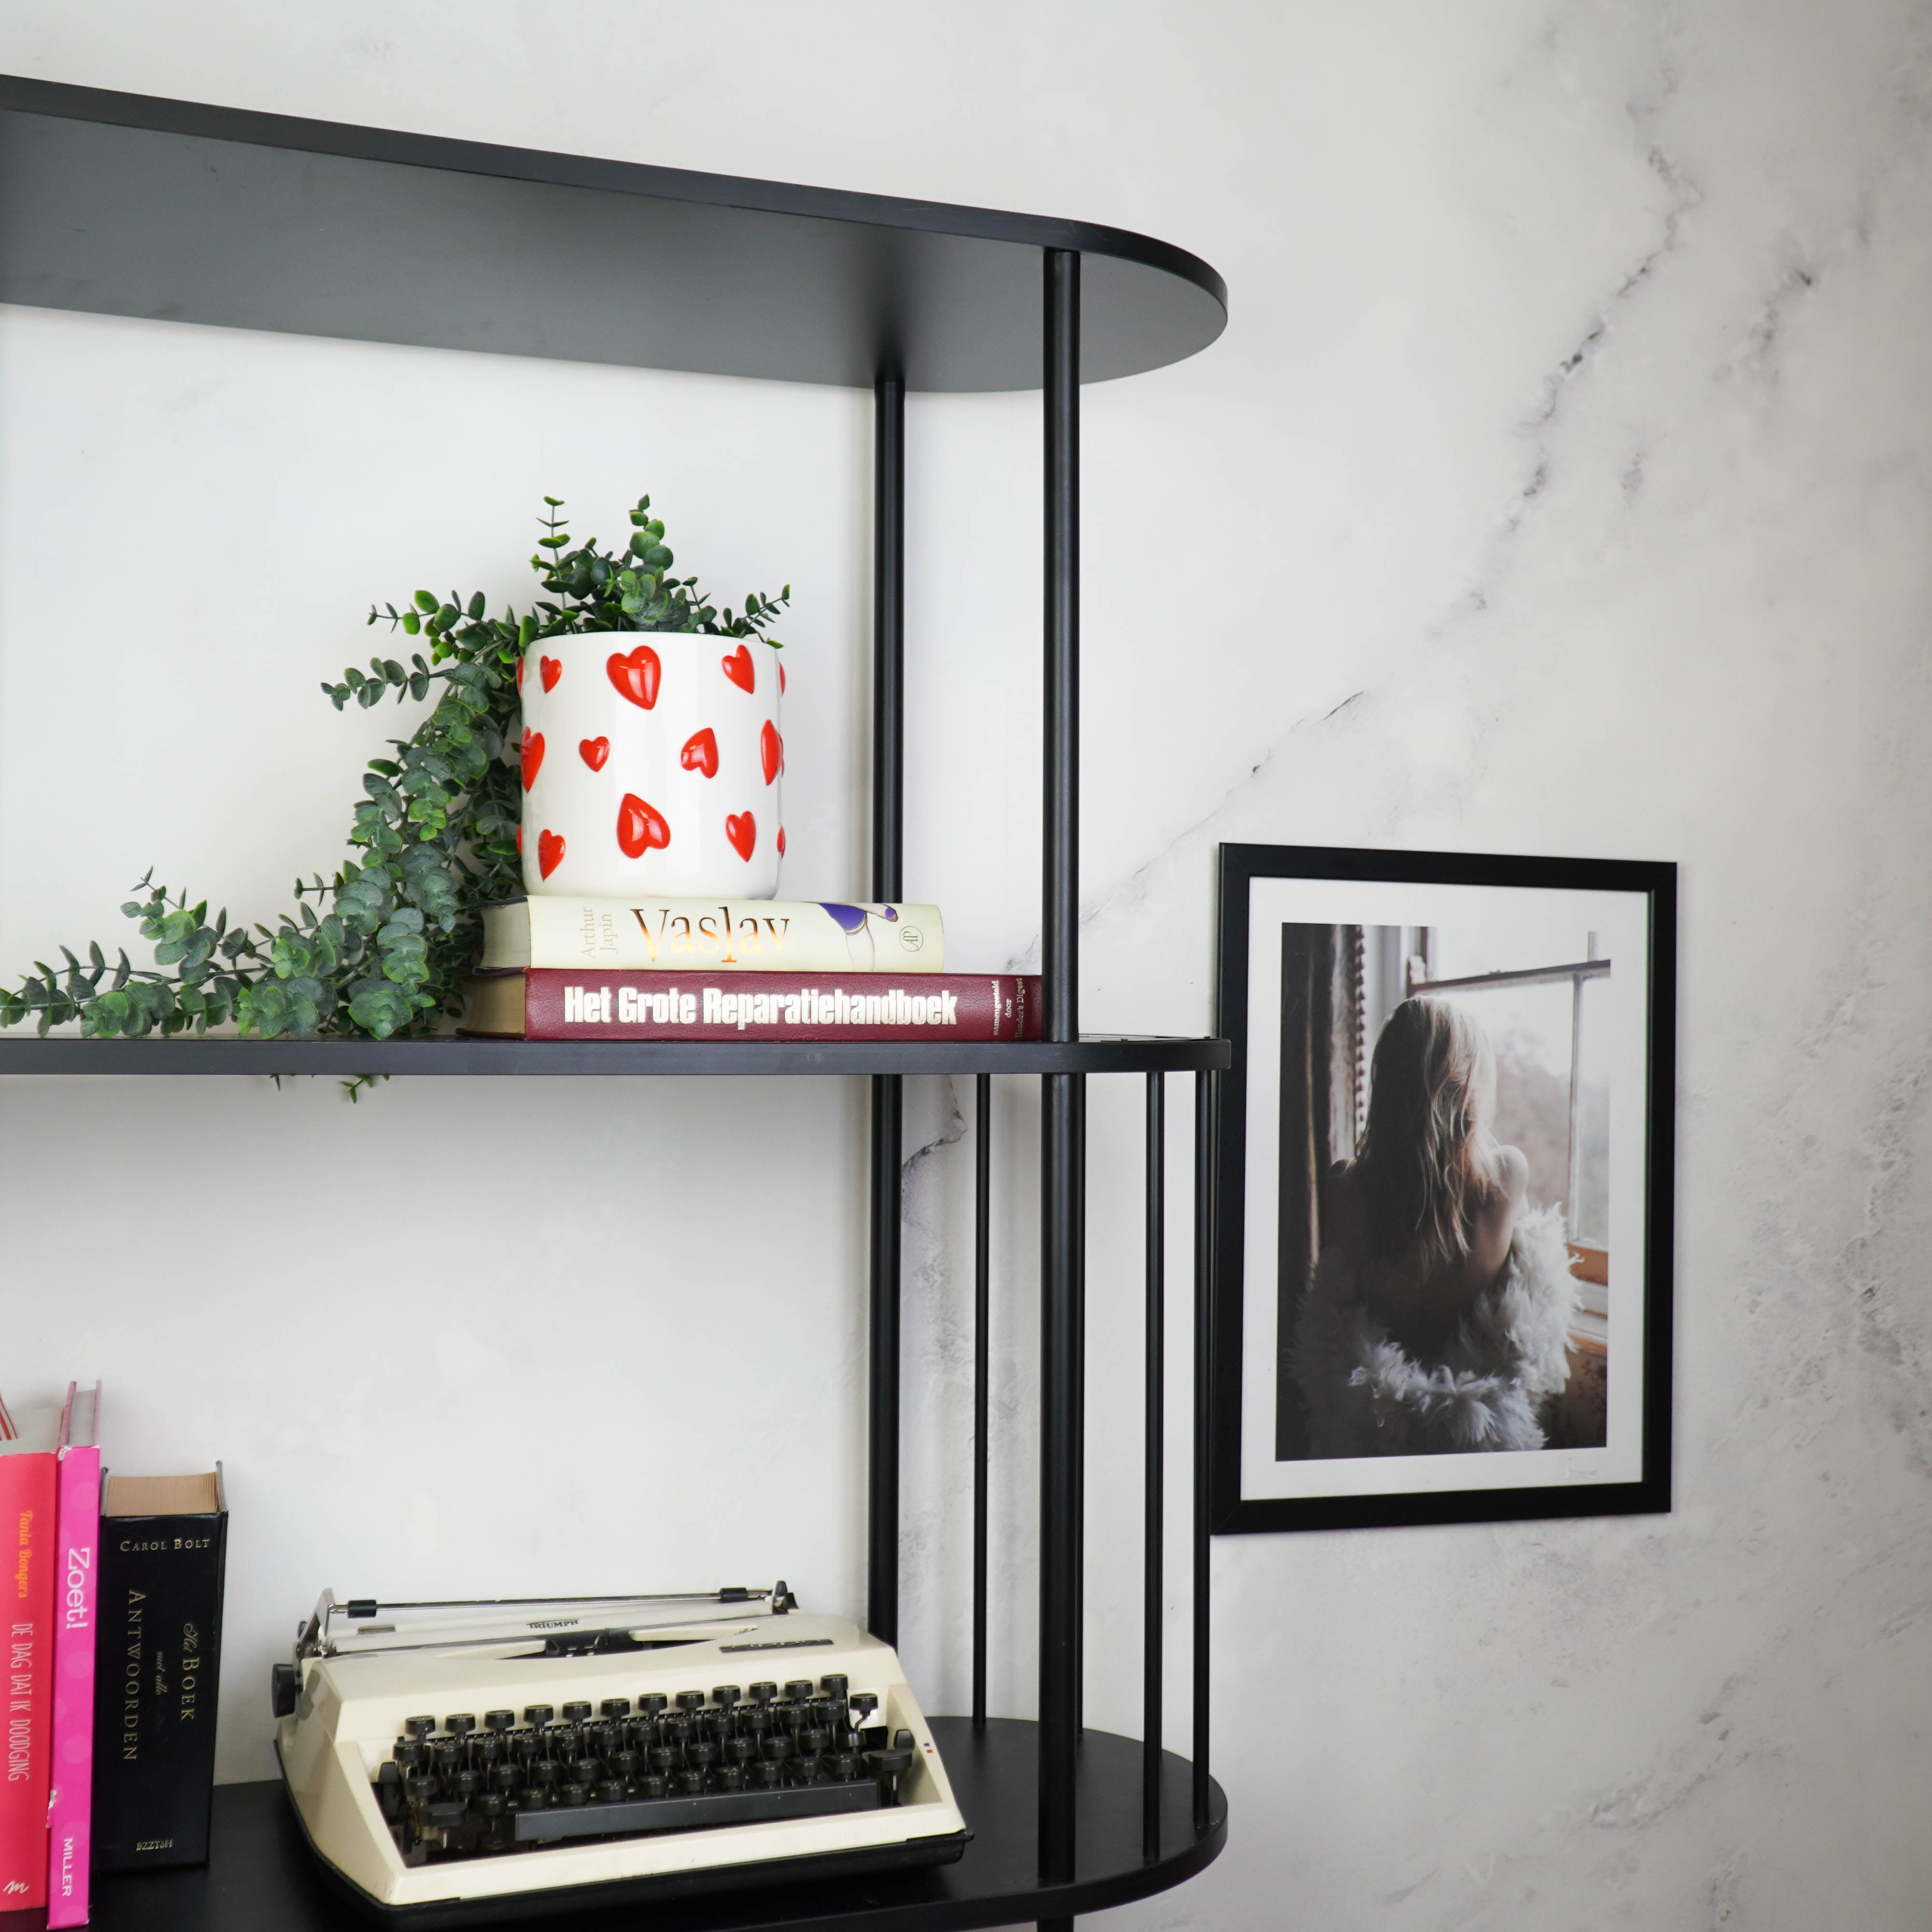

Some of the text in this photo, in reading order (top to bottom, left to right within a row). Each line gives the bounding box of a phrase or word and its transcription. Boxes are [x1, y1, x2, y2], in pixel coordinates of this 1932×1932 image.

[580, 907, 596, 959] Arthur
[599, 913, 619, 954] Japin
[629, 906, 790, 963] Vaslav
[564, 986, 957, 1030] Het Grote Reparatiehandboek
[1016, 978, 1025, 1004] Digest
[14, 1510, 33, 1599] Tania Bongers
[120, 1538, 210, 1551] CAROL BOLT
[66, 1548, 90, 1630] Zoet!
[526, 1619, 580, 1629] TRIUMPH
[123, 1589, 147, 1761] ANTWOORDEN
[155, 1675, 168, 1696] alle
[180, 1622, 201, 1721] Het BOEK
[8, 1623, 34, 1782] DE DAG DAT IK DOODGING
[61, 1837, 74, 1897] MILLER
